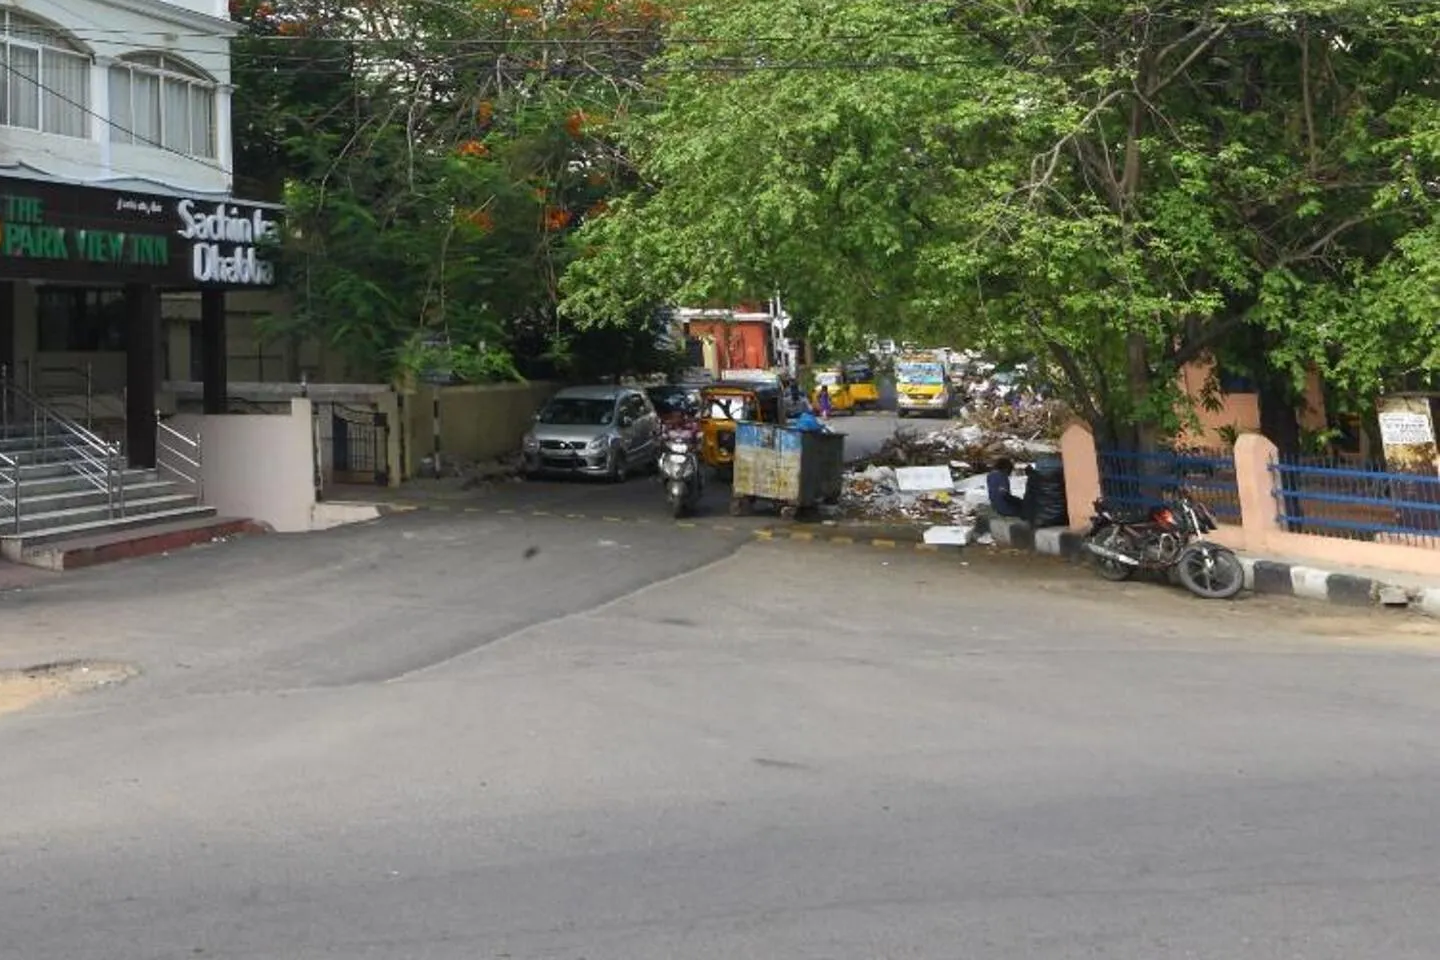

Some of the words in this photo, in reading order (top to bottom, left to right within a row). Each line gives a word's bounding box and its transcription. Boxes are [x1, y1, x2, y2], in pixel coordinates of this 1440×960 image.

[4, 195, 44, 224] THE
[176, 199, 252, 243] Sachin
[4, 222, 69, 260] PARK
[78, 229, 126, 265] VIEW
[129, 233, 169, 266] INN
